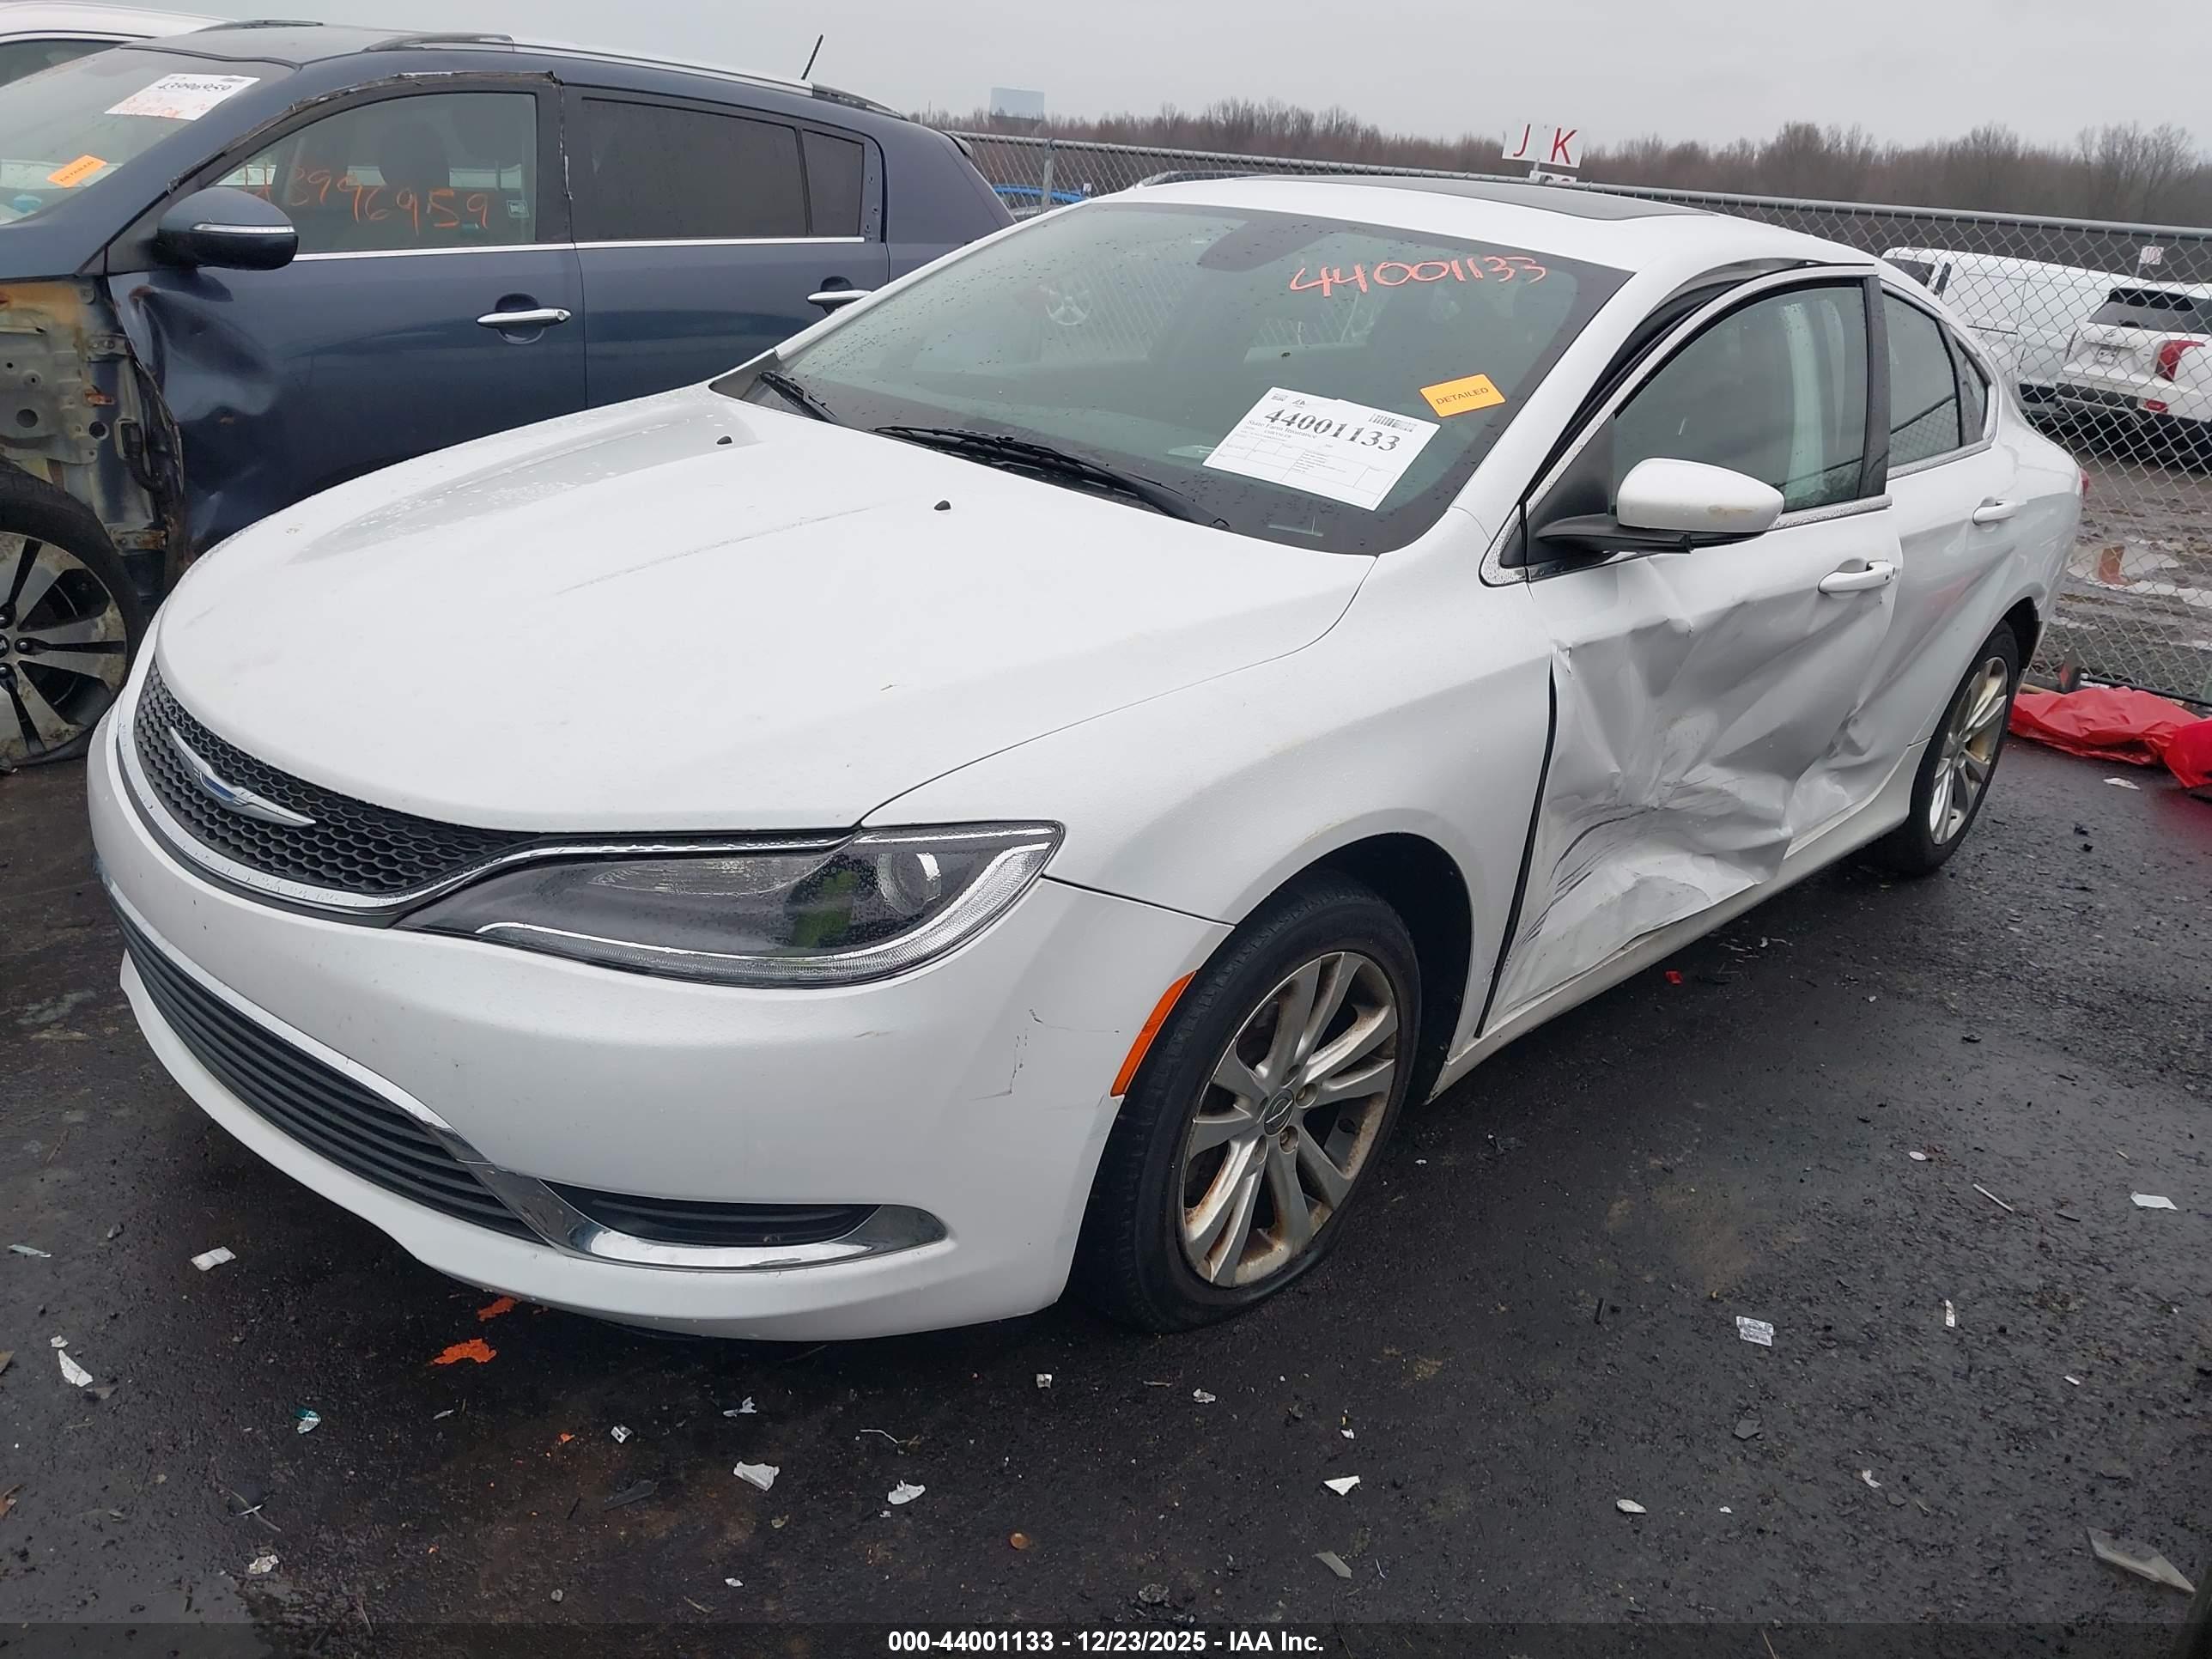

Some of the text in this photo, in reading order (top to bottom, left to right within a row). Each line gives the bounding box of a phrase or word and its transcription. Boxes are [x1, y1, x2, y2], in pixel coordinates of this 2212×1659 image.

[1513, 124, 1577, 165] J K
[1290, 257, 1546, 297] 44001133
[1436, 387, 1489, 404] DETAILED
[1264, 409, 1401, 451] 44001133
